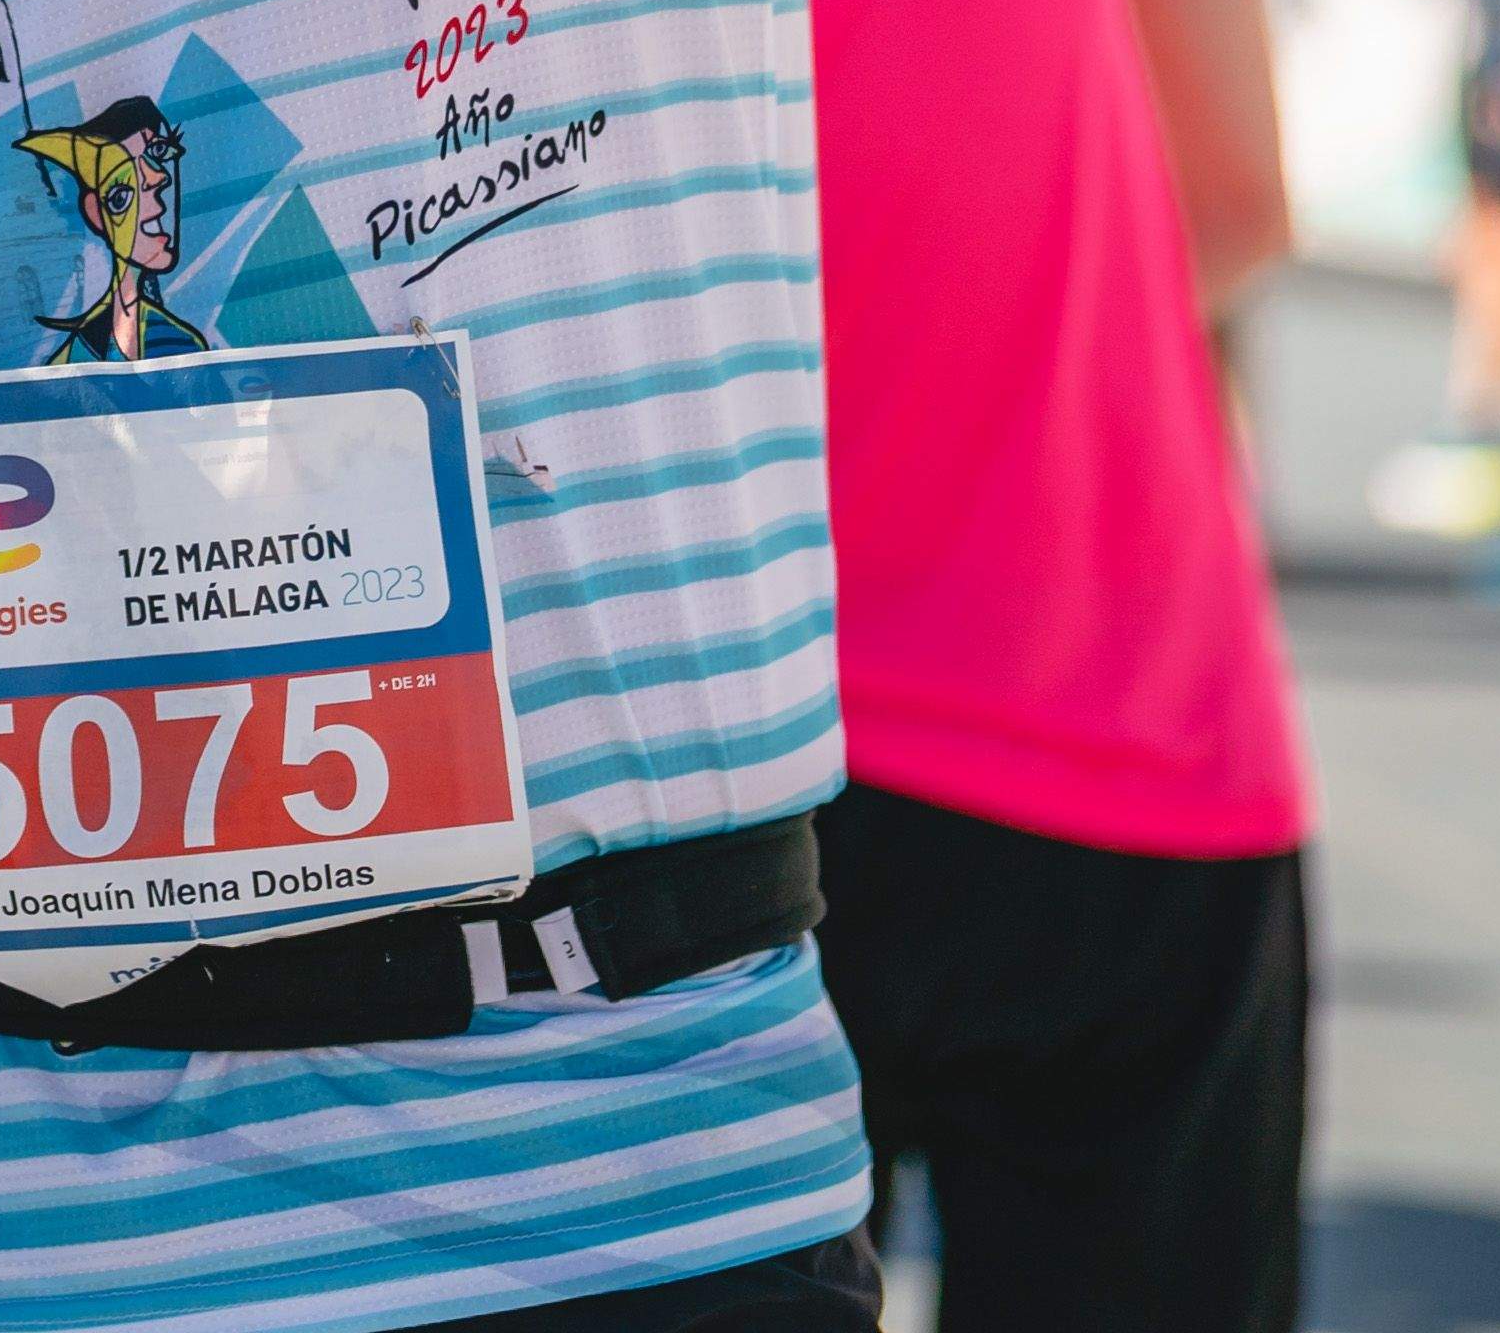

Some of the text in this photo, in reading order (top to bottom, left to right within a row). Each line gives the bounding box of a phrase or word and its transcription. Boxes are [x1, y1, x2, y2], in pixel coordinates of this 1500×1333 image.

[436, 87, 514, 161] Año
[365, 109, 606, 260] Picassiano
[118, 525, 353, 579] 1/2 MARATÓN
[124, 565, 426, 627] DE MÁLAGA 2023
[391, 676, 413, 691] DE
[416, 673, 437, 688] 2H
[2, 882, 136, 920] Joaquín
[146, 875, 241, 909] Mena
[251, 861, 376, 899] Doblas
